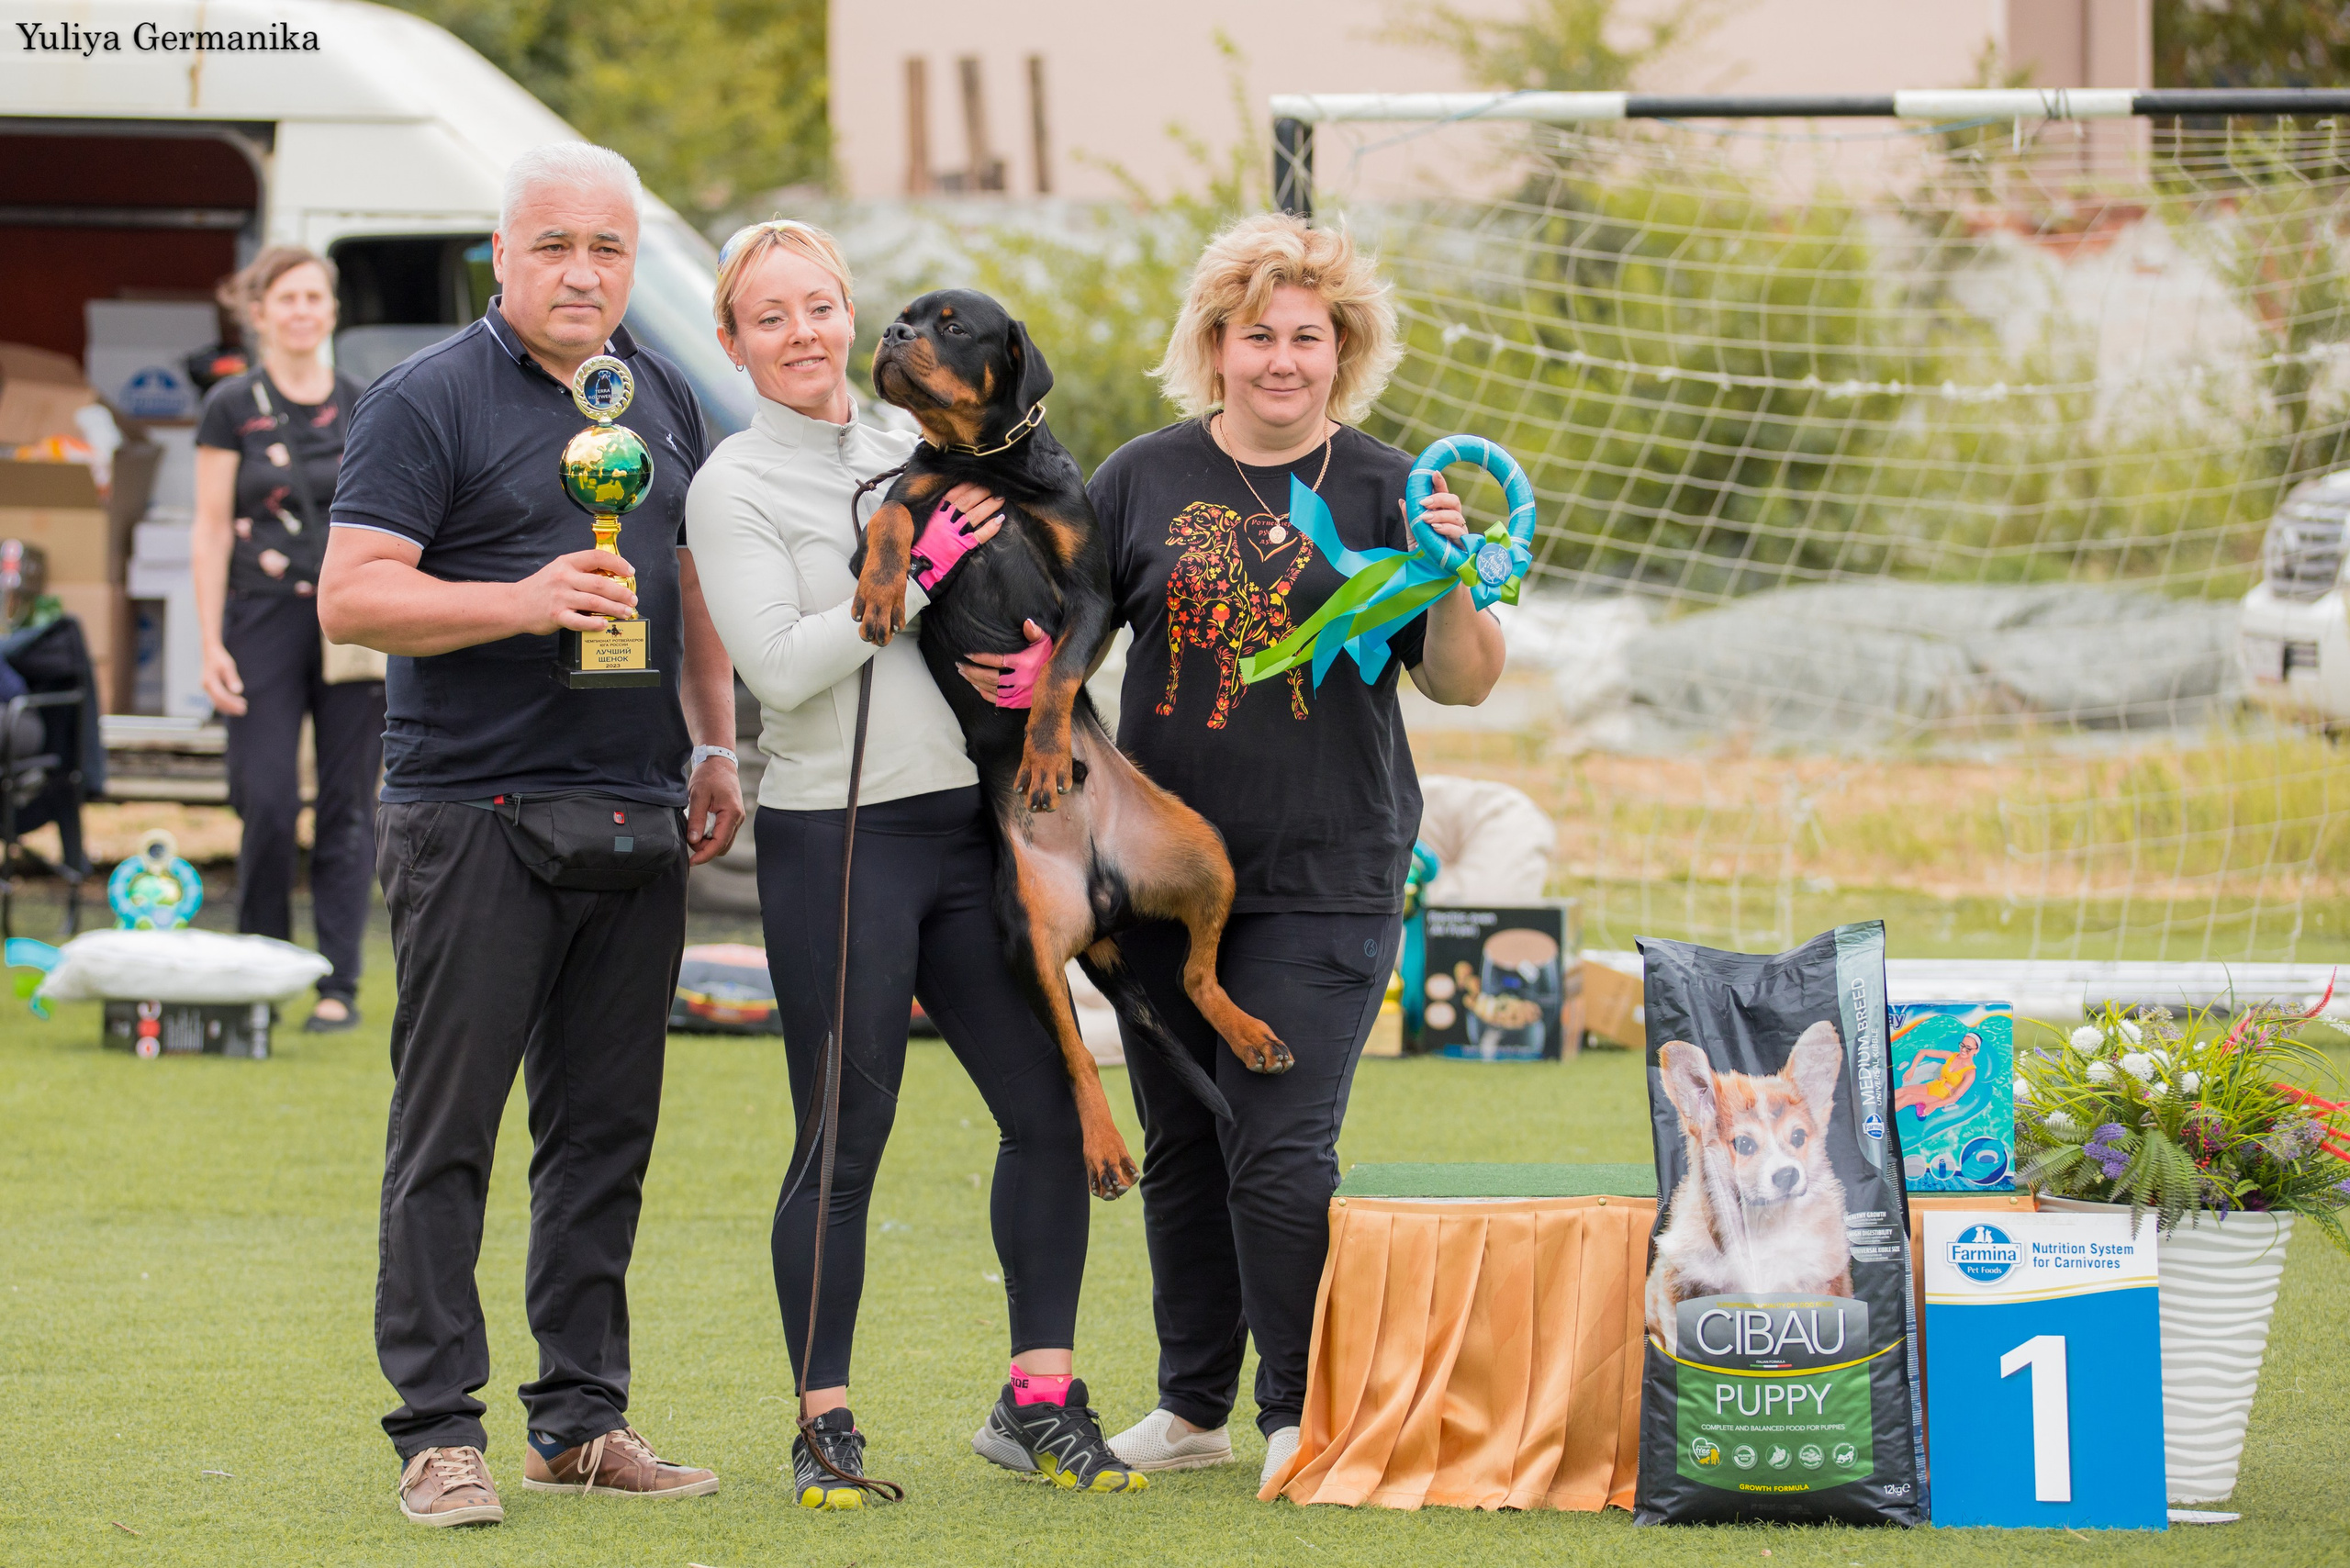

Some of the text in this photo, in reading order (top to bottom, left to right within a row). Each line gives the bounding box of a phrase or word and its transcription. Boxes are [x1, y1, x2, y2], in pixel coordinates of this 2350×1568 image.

[1251, 519, 1292, 527] Ротвелер
[1852, 977, 1876, 1106] MEDIUM BREED
[1871, 1028, 1881, 1106] UNIVERSAL KIBBLE
[1952, 1245, 2017, 1261] Farmina
[2032, 1242, 2134, 1256] Nutrition System
[1981, 1266, 2002, 1274] Foods
[2033, 1257, 2121, 1269] for Carnivores
[1696, 1308, 1845, 1356] CIBAU
[1716, 1383, 1832, 1417] PUPPY
[2000, 1335, 2072, 1502] 1
[1695, 1445, 1711, 1454] free
[1739, 1483, 1809, 1493] GROWTH FORMULA
